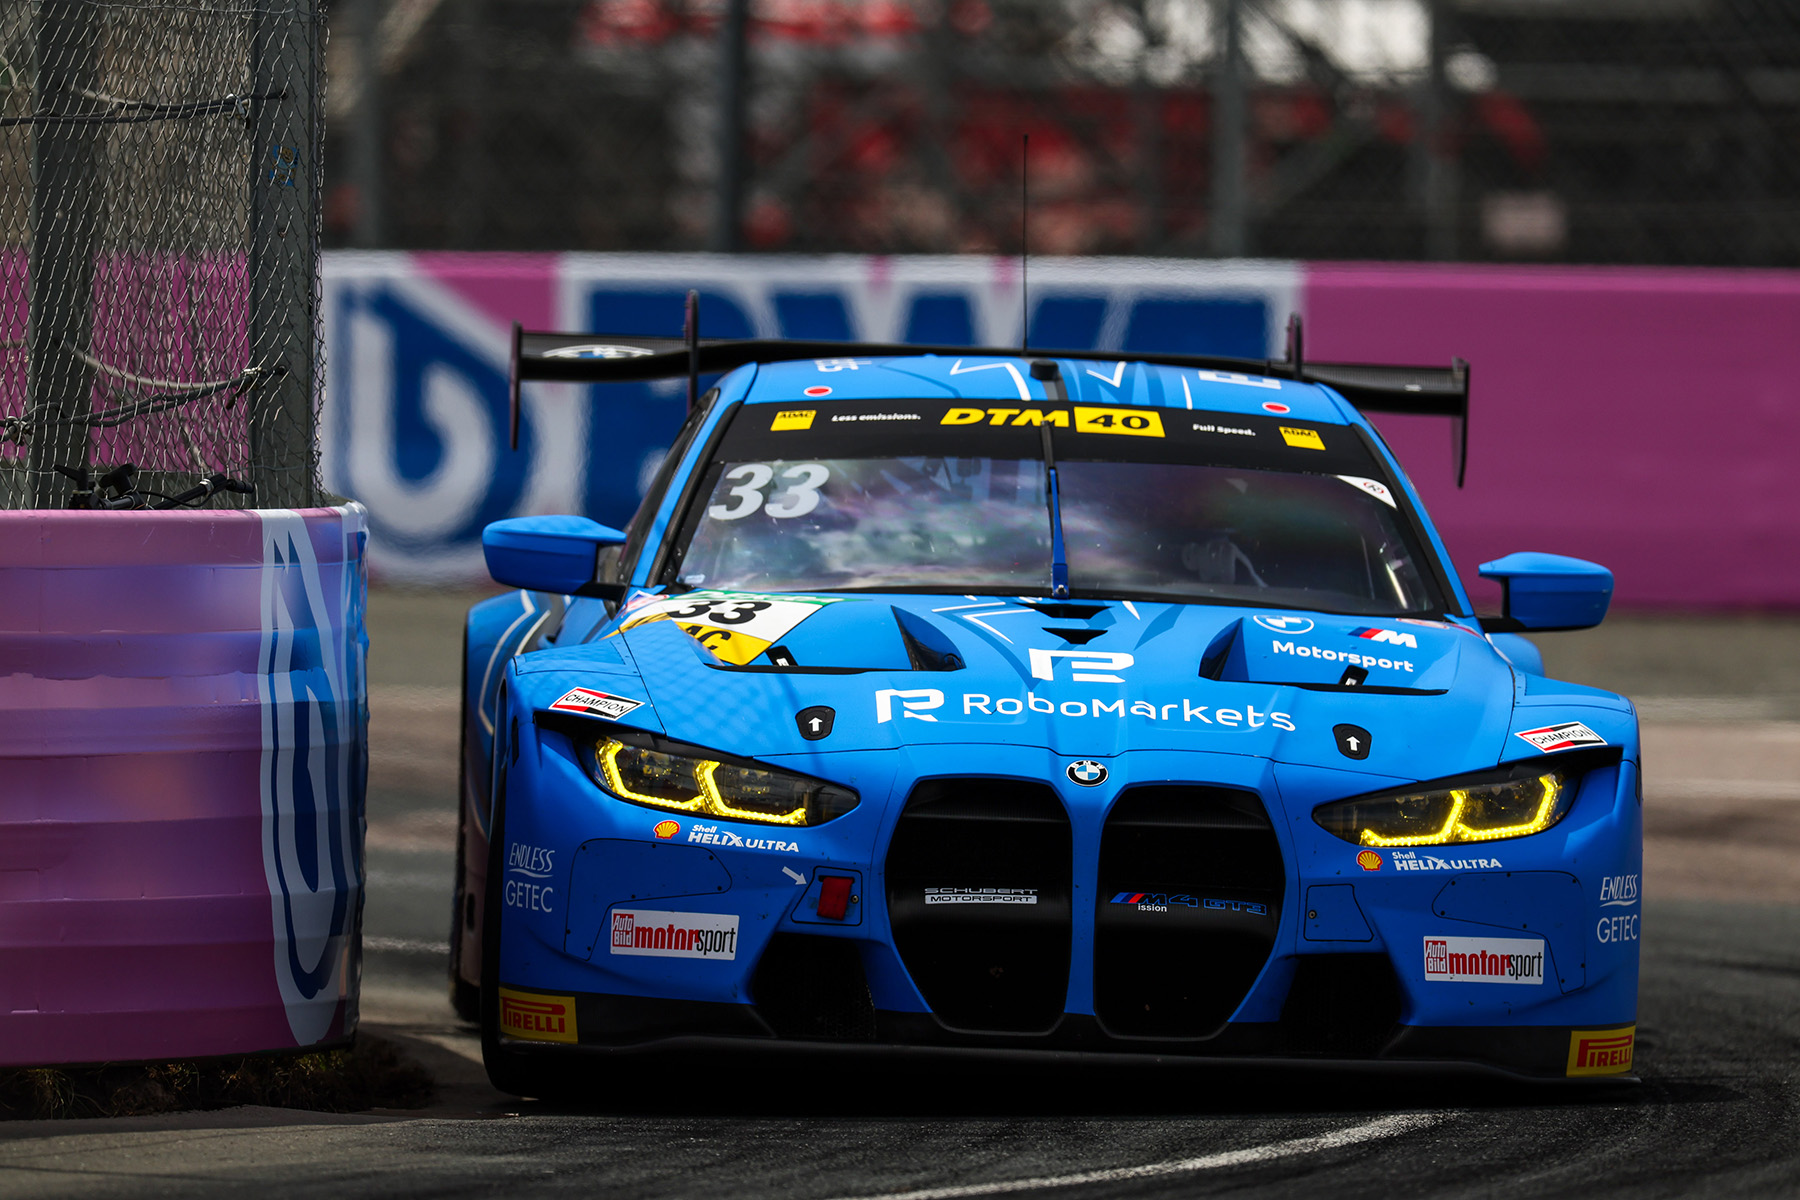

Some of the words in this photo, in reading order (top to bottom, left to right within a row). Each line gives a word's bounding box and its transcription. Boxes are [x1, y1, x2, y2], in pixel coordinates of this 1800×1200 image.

[831, 414, 858, 422] Less
[858, 413, 921, 422] emissions.
[940, 408, 1069, 427] DTM
[1087, 414, 1150, 429] 40
[1192, 423, 1216, 433] Full
[1216, 425, 1256, 437] Speed.
[708, 463, 830, 520] 33
[668, 600, 772, 625] 33
[1272, 640, 1414, 673] Motorsport
[565, 693, 627, 713] CHAMPION
[962, 691, 1297, 732] RoboMarkets
[1532, 728, 1593, 745] CHAMPION
[691, 824, 718, 834] Shell
[687, 830, 745, 847] HELIX
[745, 839, 800, 853] ULTRA
[508, 842, 556, 873] ENDLESS
[1392, 851, 1416, 860] Shell
[1393, 855, 1451, 871] HELIX
[1450, 858, 1503, 870] ULTRA
[505, 880, 554, 913] GETEC
[924, 887, 1038, 895] SCHUBERT
[1600, 874, 1638, 901] ENDLESS
[930, 895, 1033, 903] MOTORSPORT
[1134, 892, 1199, 908] M4
[1203, 898, 1267, 916] GT3
[1137, 903, 1168, 913] ission
[612, 914, 633, 931] Auto
[1597, 914, 1638, 944] GETEC
[613, 930, 632, 947] Bild
[1426, 941, 1447, 958] Auto
[1427, 957, 1446, 973] Bild
[501, 996, 567, 1034] PIRELLI
[1576, 1034, 1633, 1068] PIRELLI
